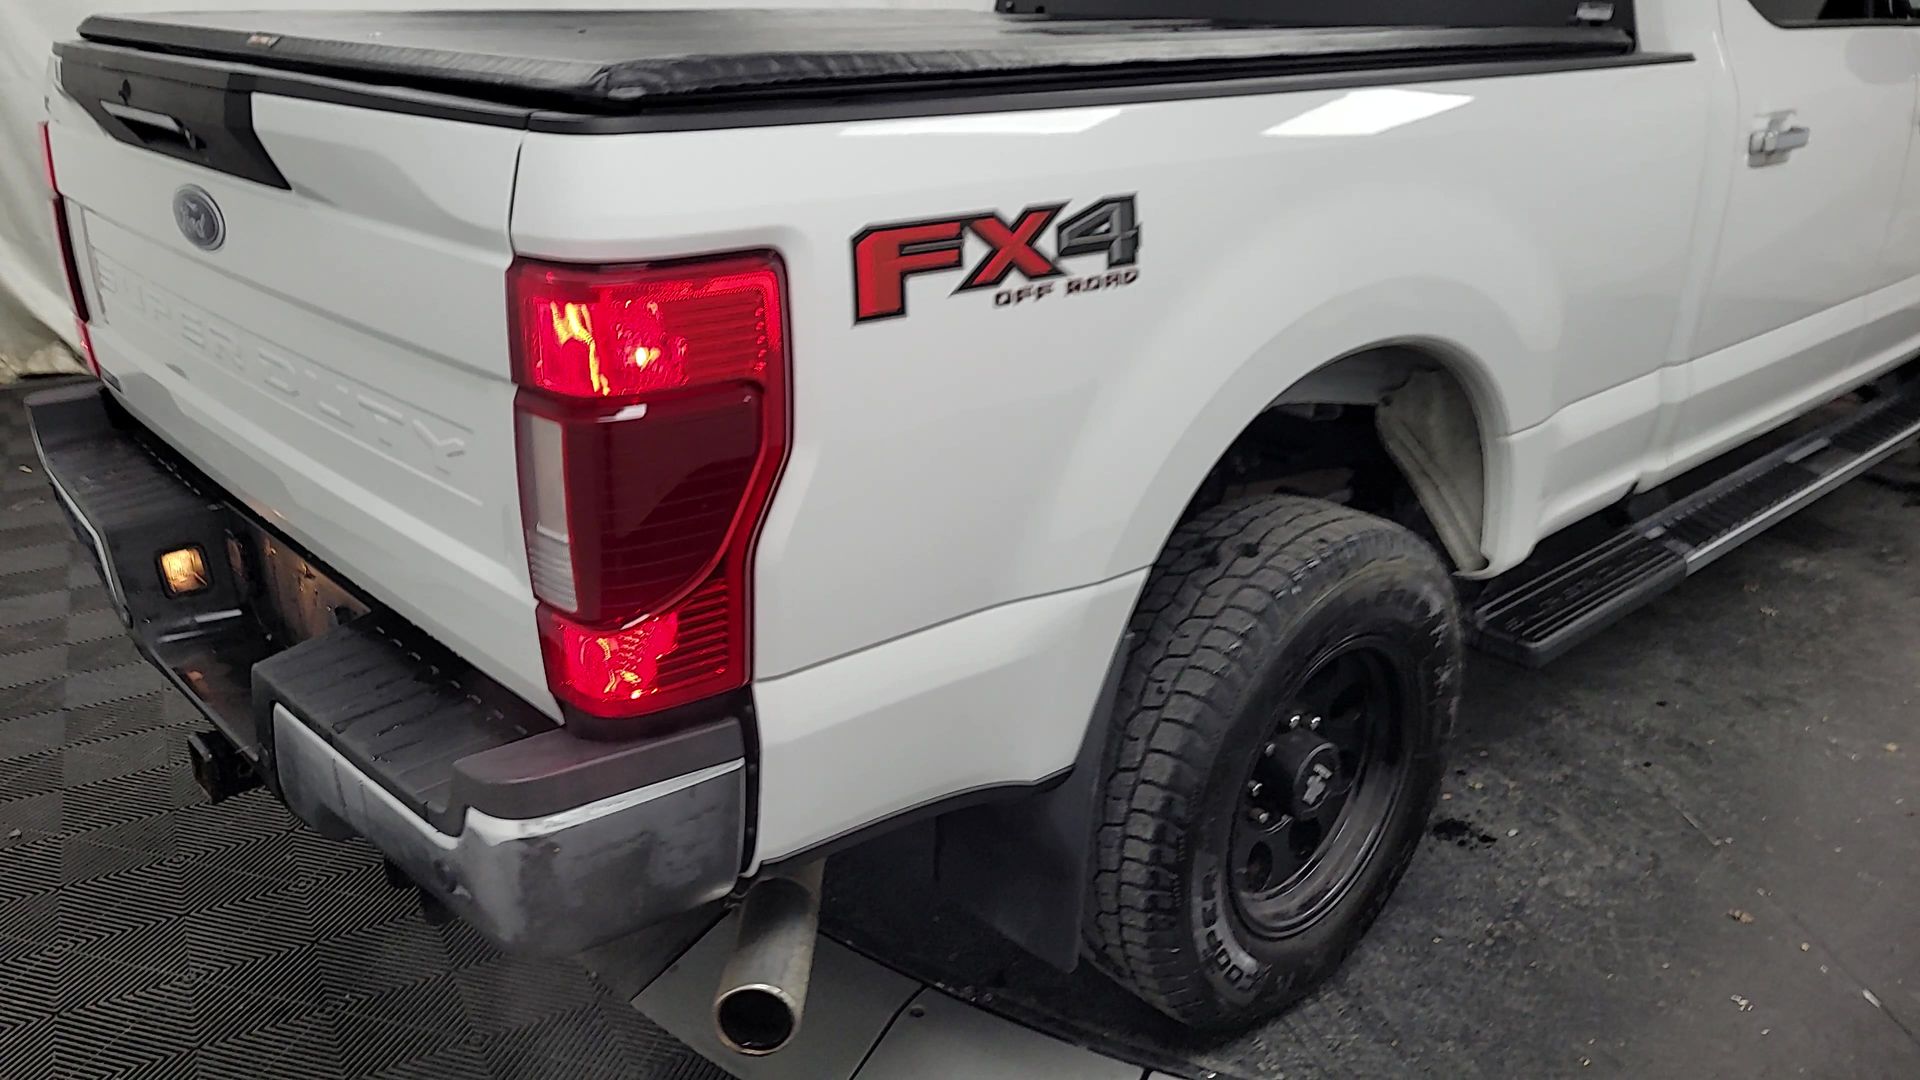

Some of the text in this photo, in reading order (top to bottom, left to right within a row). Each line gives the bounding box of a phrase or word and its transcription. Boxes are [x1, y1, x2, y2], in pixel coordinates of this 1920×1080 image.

[850, 192, 1140, 328] FX4
[993, 268, 1140, 308] OFF ROAD
[96, 262, 473, 477] SUPER DUTY
